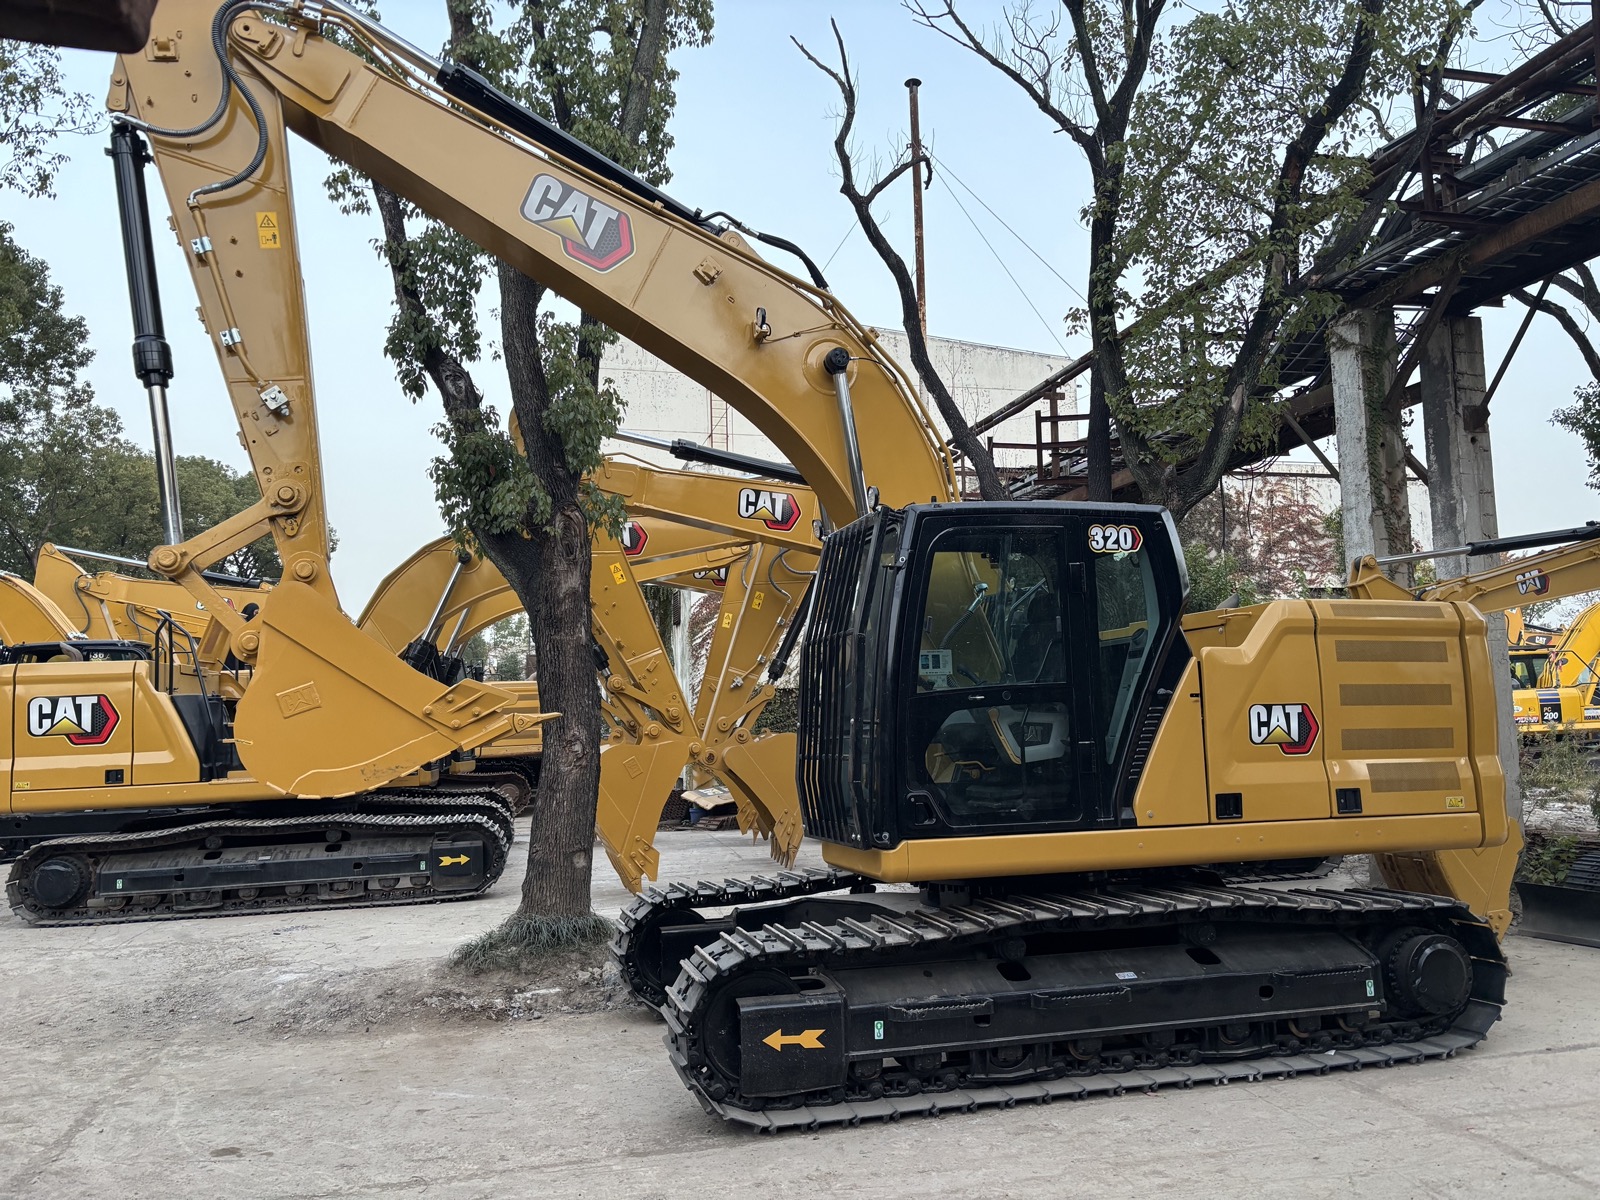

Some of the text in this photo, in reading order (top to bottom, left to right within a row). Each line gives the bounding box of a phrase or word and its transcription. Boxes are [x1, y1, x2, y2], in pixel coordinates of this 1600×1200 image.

[523, 175, 619, 250] CAT
[739, 488, 788, 521] CAT
[1090, 527, 1133, 550] 320
[1516, 569, 1541, 594] CAT
[1535, 636, 1547, 645] CAT
[29, 695, 98, 736] CAT
[1249, 704, 1303, 744] CAT
[1543, 711, 1559, 720] 200
